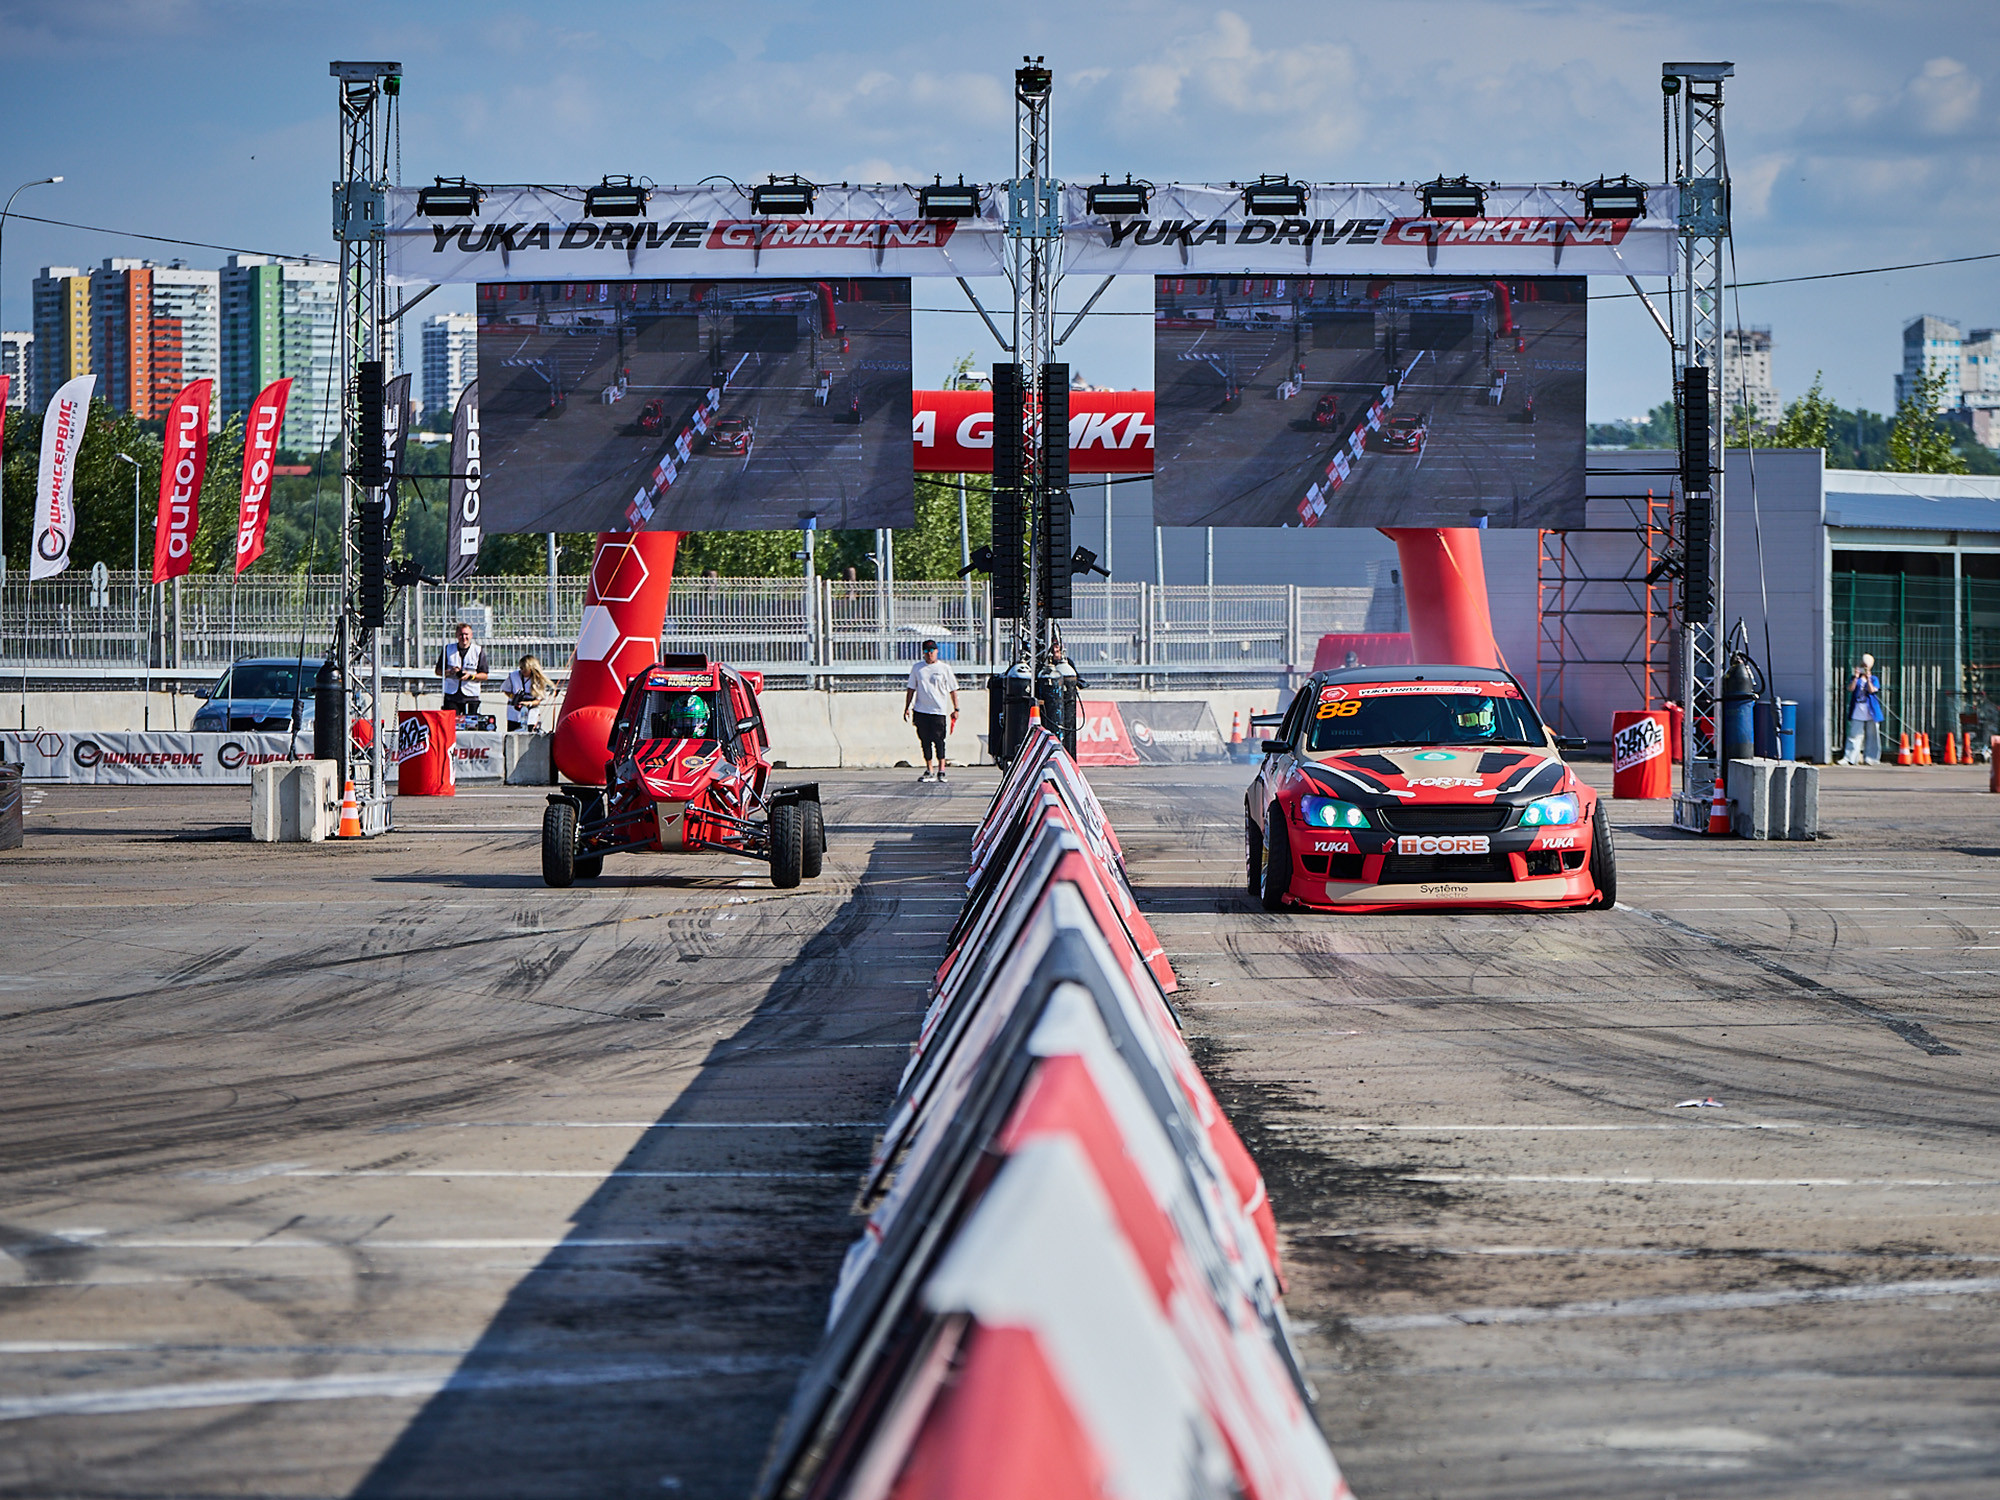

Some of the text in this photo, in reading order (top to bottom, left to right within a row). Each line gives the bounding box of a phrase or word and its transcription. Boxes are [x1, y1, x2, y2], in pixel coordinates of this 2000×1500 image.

[432, 221, 938, 252] YUKA DRIVE GYMKHANA
[1108, 218, 1614, 249] YUKA DRIVE GYMKHANA
[50, 398, 73, 524] ШИНСЕРВИС
[168, 404, 200, 558] auto.ru
[237, 405, 278, 554] auto.ru
[1316, 700, 1362, 720] 88
[1615, 721, 1654, 746] YUKA
[1617, 729, 1662, 760] DRIVE
[102, 752, 204, 765] ШИНСЕРВИС
[1407, 777, 1485, 788] FORTIS
[1314, 841, 1349, 852] YUKA
[1541, 837, 1575, 848] YUKA
